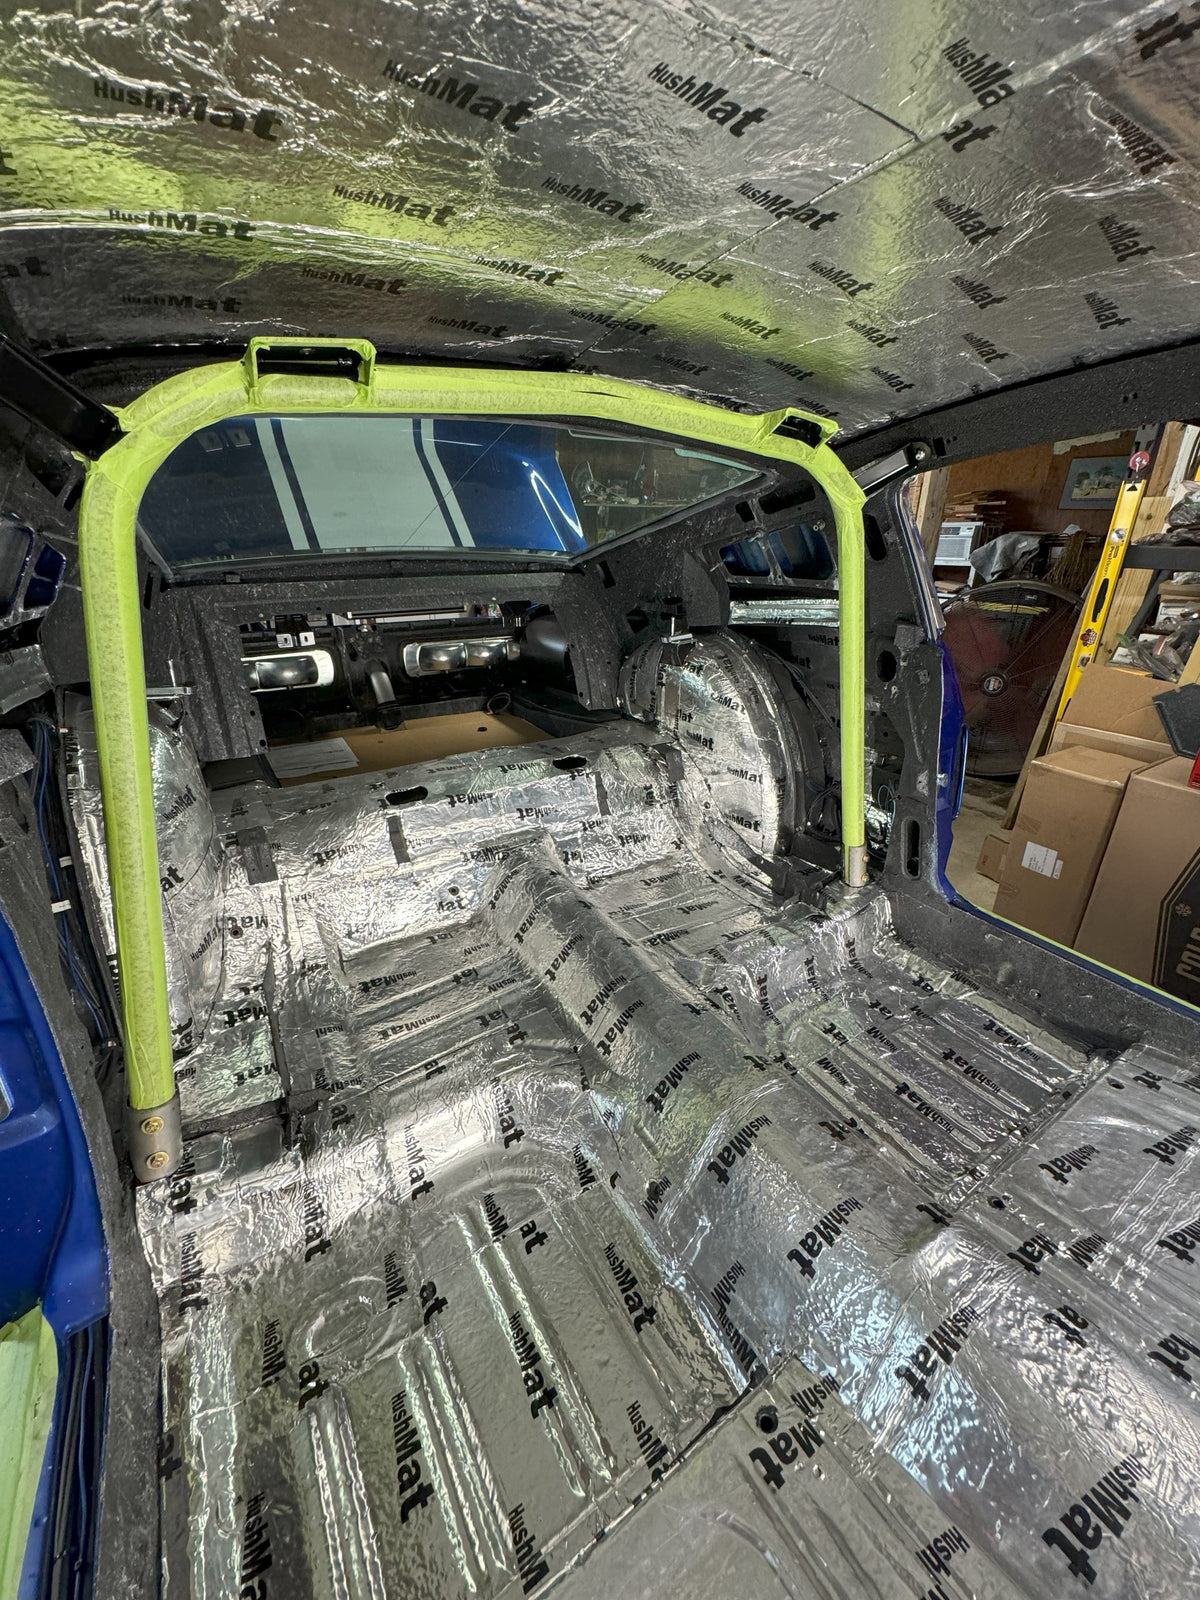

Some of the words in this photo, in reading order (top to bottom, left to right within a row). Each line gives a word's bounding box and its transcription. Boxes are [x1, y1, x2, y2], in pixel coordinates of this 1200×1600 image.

[94, 77, 283, 142] HushMat
[382, 59, 534, 133] HushMat
[647, 61, 769, 138] HushMat
[332, 184, 457, 227] HushMat
[541, 176, 650, 223] HushMat
[932, 195, 1003, 245] HushMat
[108, 208, 256, 242] HushMat
[302, 266, 408, 296] HushMat
[475, 256, 564, 287] HushMat
[807, 260, 875, 298] HushMat
[427, 315, 508, 338] HushMat
[719, 311, 782, 340] HushMat
[844, 319, 900, 348] HushMat
[764, 357, 815, 382] HushMat
[869, 365, 915, 393] HushMat
[163, 784, 196, 821] HushMat
[358, 970, 418, 994] HushMat
[543, 934, 586, 984] HushMat
[579, 975, 628, 1027] HushMat
[756, 973, 783, 1026] HushMat
[376, 1013, 442, 1042] HushMat
[596, 999, 646, 1058] HushMat
[645, 1050, 703, 1115] HushMat
[943, 1047, 1002, 1094] HushMat
[490, 1076, 526, 1150] HushMat
[895, 1081, 955, 1134] HushMat
[404, 1123, 436, 1202] HushMat
[706, 1114, 773, 1187] HushMat
[518, 1219, 550, 1256] at
[786, 1196, 865, 1280] HushMat
[418, 1280, 449, 1326] at
[602, 1242, 656, 1334] HushMat
[508, 1311, 558, 1419] HushMat
[895, 1304, 985, 1403] HushMat
[391, 1391, 435, 1524] HushMat
[749, 1418, 824, 1490] Mat
[1041, 1453, 1152, 1586] HushMat
